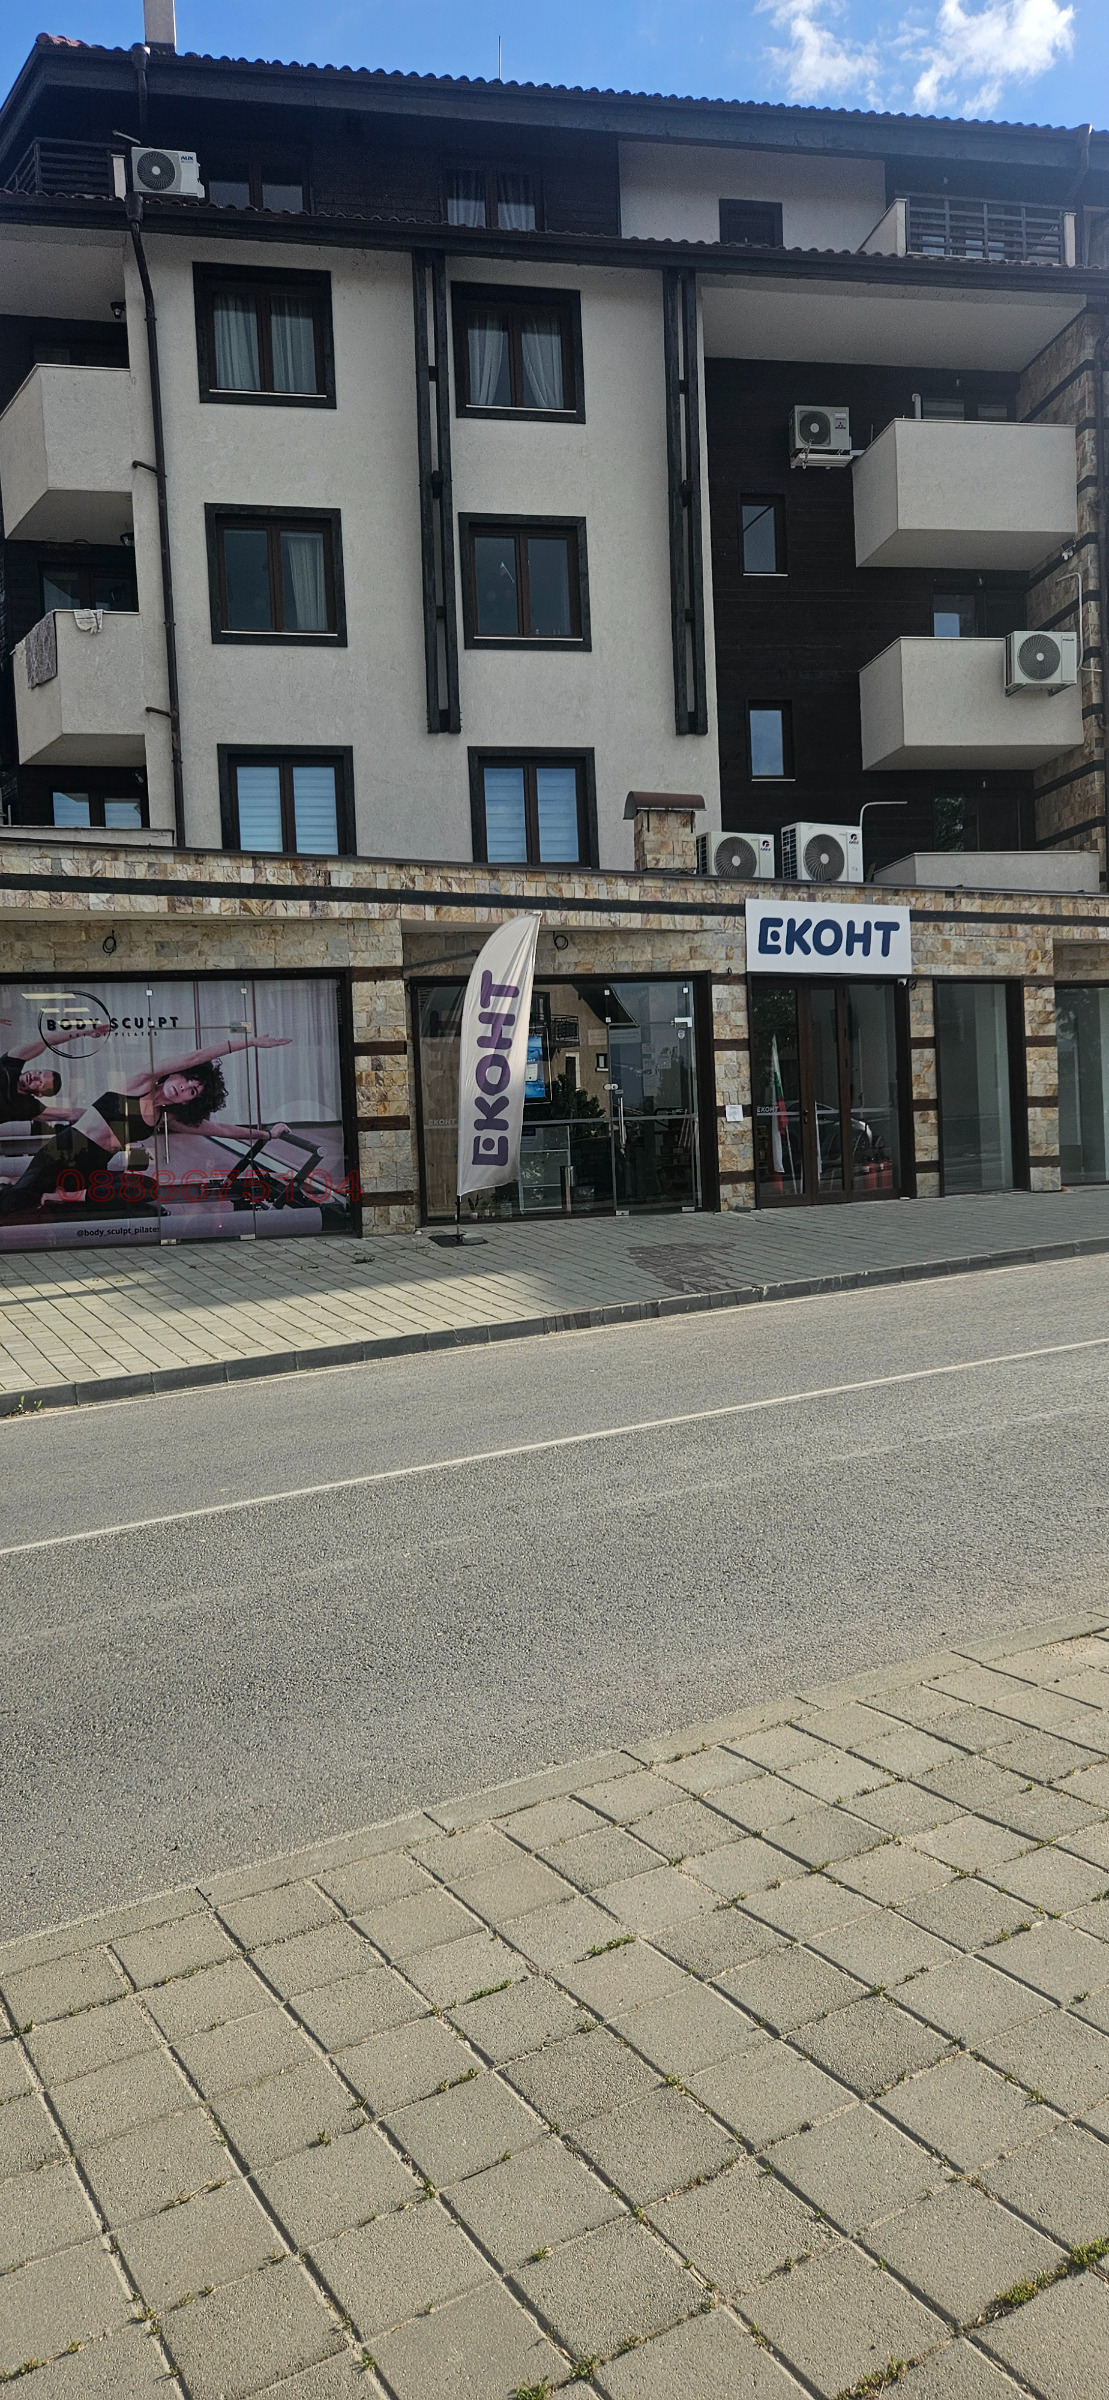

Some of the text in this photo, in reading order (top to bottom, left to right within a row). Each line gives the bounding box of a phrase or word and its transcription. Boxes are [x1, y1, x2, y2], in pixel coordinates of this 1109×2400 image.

[757, 916, 901, 958] ЕКОНТ
[46, 1016, 179, 1031] BODY SCULPT
[471, 969, 520, 1167] ЕКОНТ
